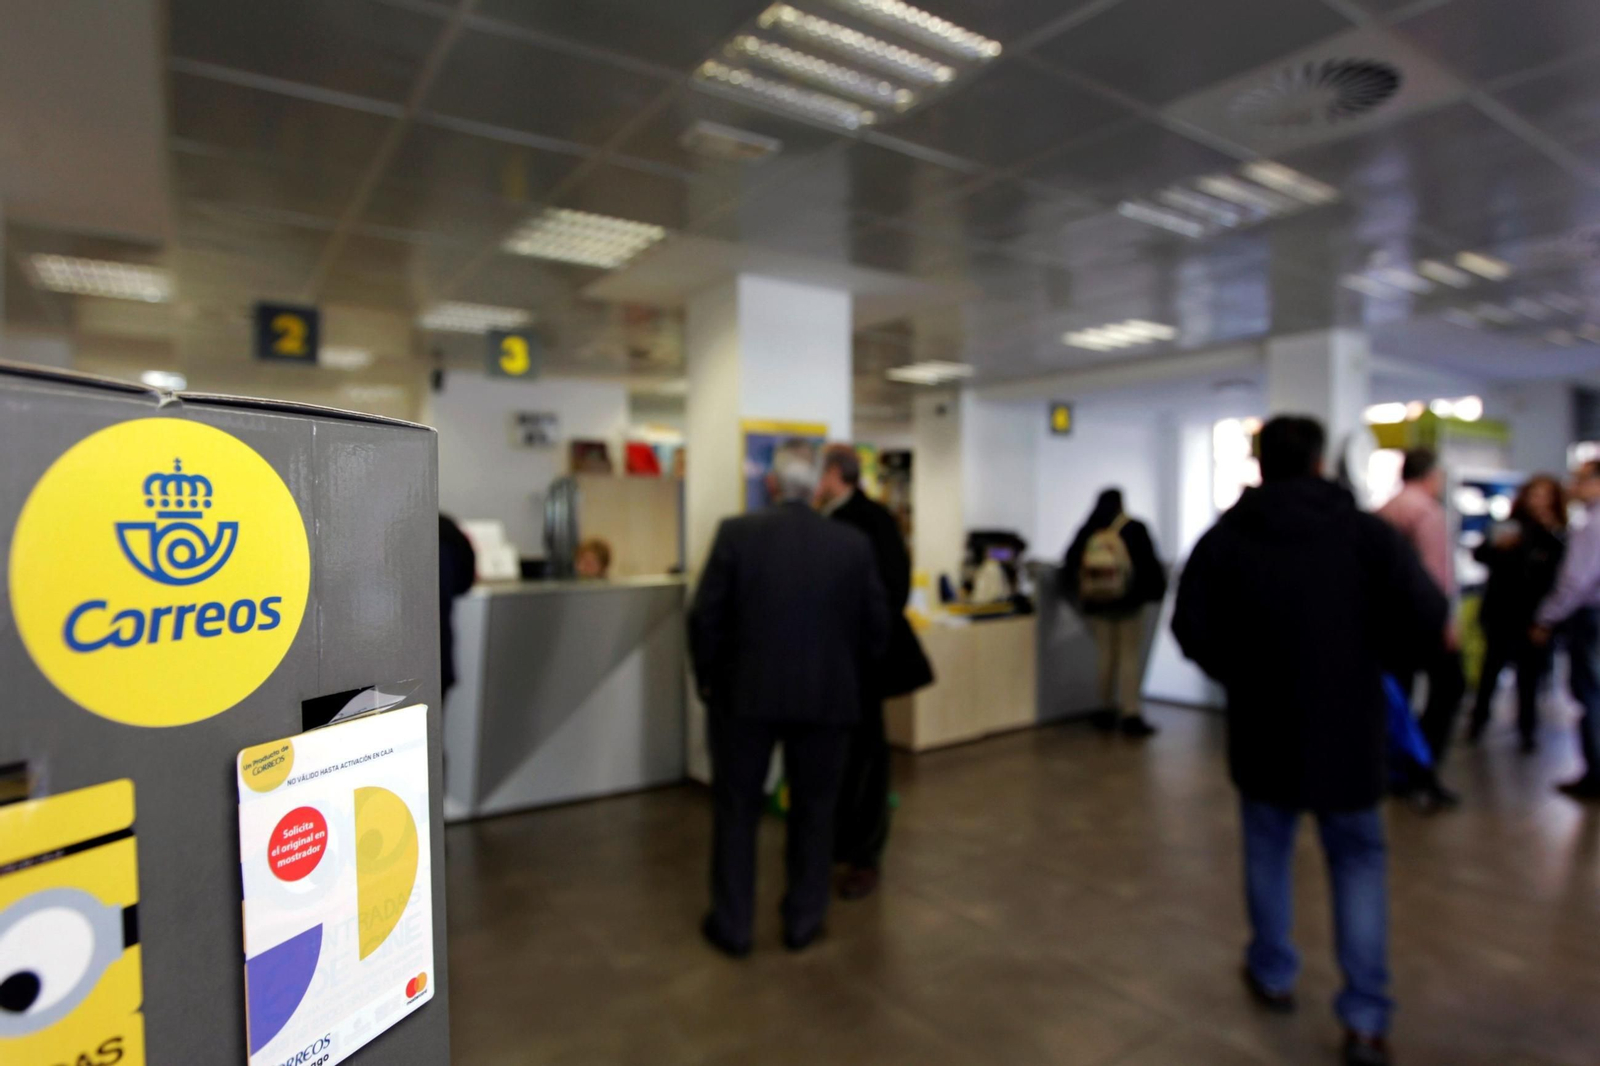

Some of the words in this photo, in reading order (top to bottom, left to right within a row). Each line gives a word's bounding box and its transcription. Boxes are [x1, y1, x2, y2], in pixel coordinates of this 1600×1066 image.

[270, 313, 308, 356] 2
[499, 335, 531, 376] 3
[63, 597, 282, 653] Correos
[243, 763, 253, 771] Un
[252, 750, 280, 767] Producto
[280, 745, 289, 753] de
[251, 755, 286, 776] CORREOS
[287, 778, 297, 787] NO
[297, 771, 319, 783] VÁLIDO
[319, 764, 340, 776] HASTA
[340, 754, 372, 770] ACTIVACIÓN
[372, 751, 380, 760] EN
[380, 747, 394, 757] CAJA
[271, 845, 280, 857] el
[281, 832, 314, 851] original
[314, 830, 326, 840] en
[282, 822, 314, 839] Solicita
[277, 844, 321, 868] mostrador
